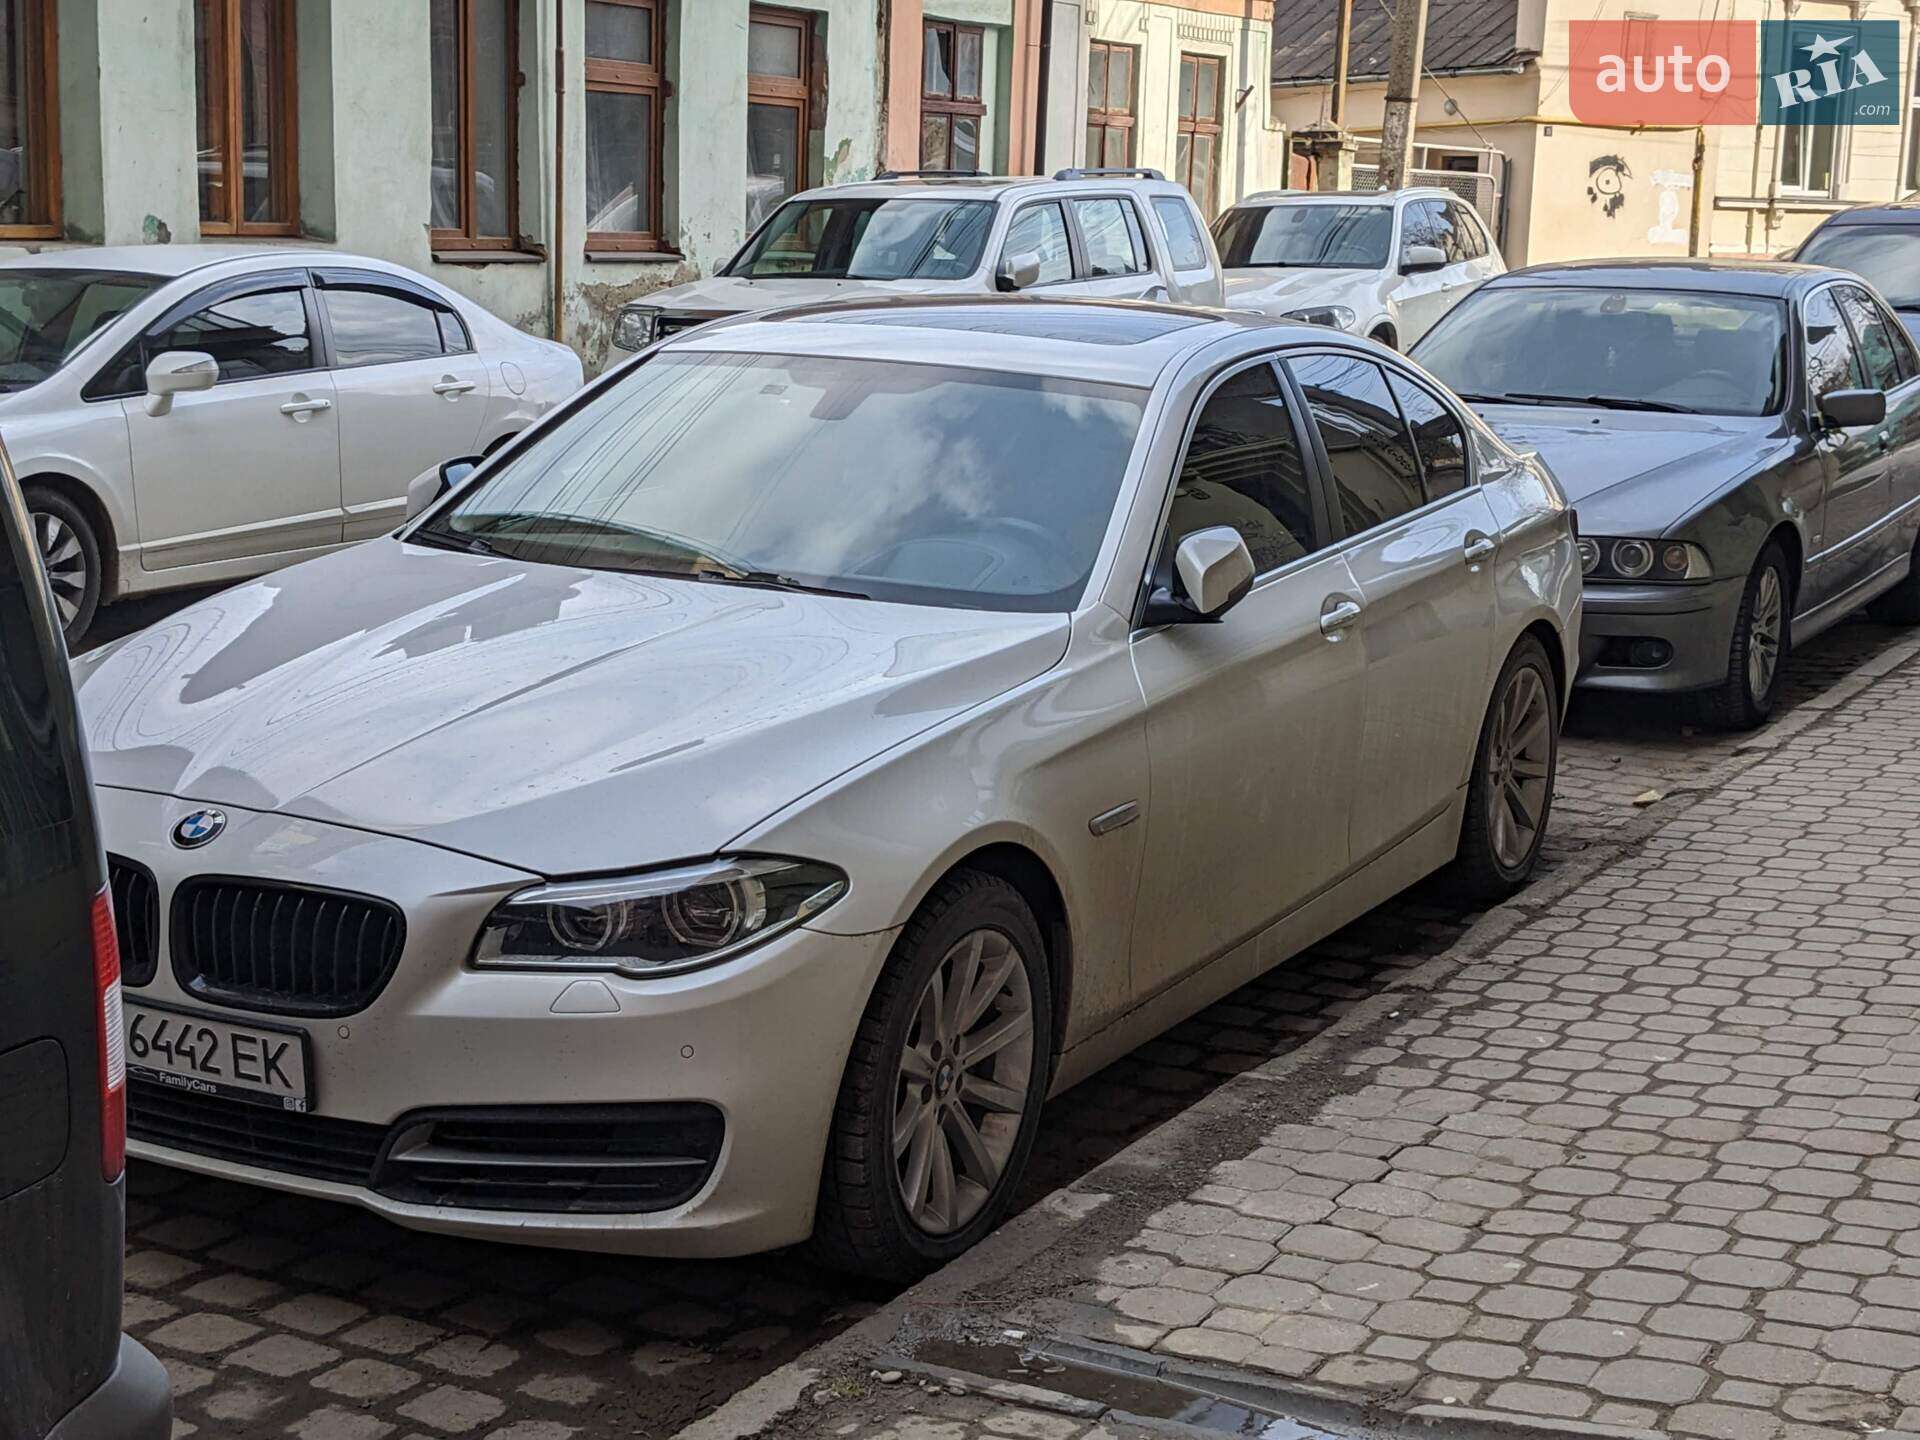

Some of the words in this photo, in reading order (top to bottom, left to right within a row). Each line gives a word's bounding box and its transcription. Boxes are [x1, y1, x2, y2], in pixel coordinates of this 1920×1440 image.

[129, 1013, 221, 1076] 6442
[230, 1032, 294, 1089] EK
[159, 1072, 217, 1094] FamilyCars
